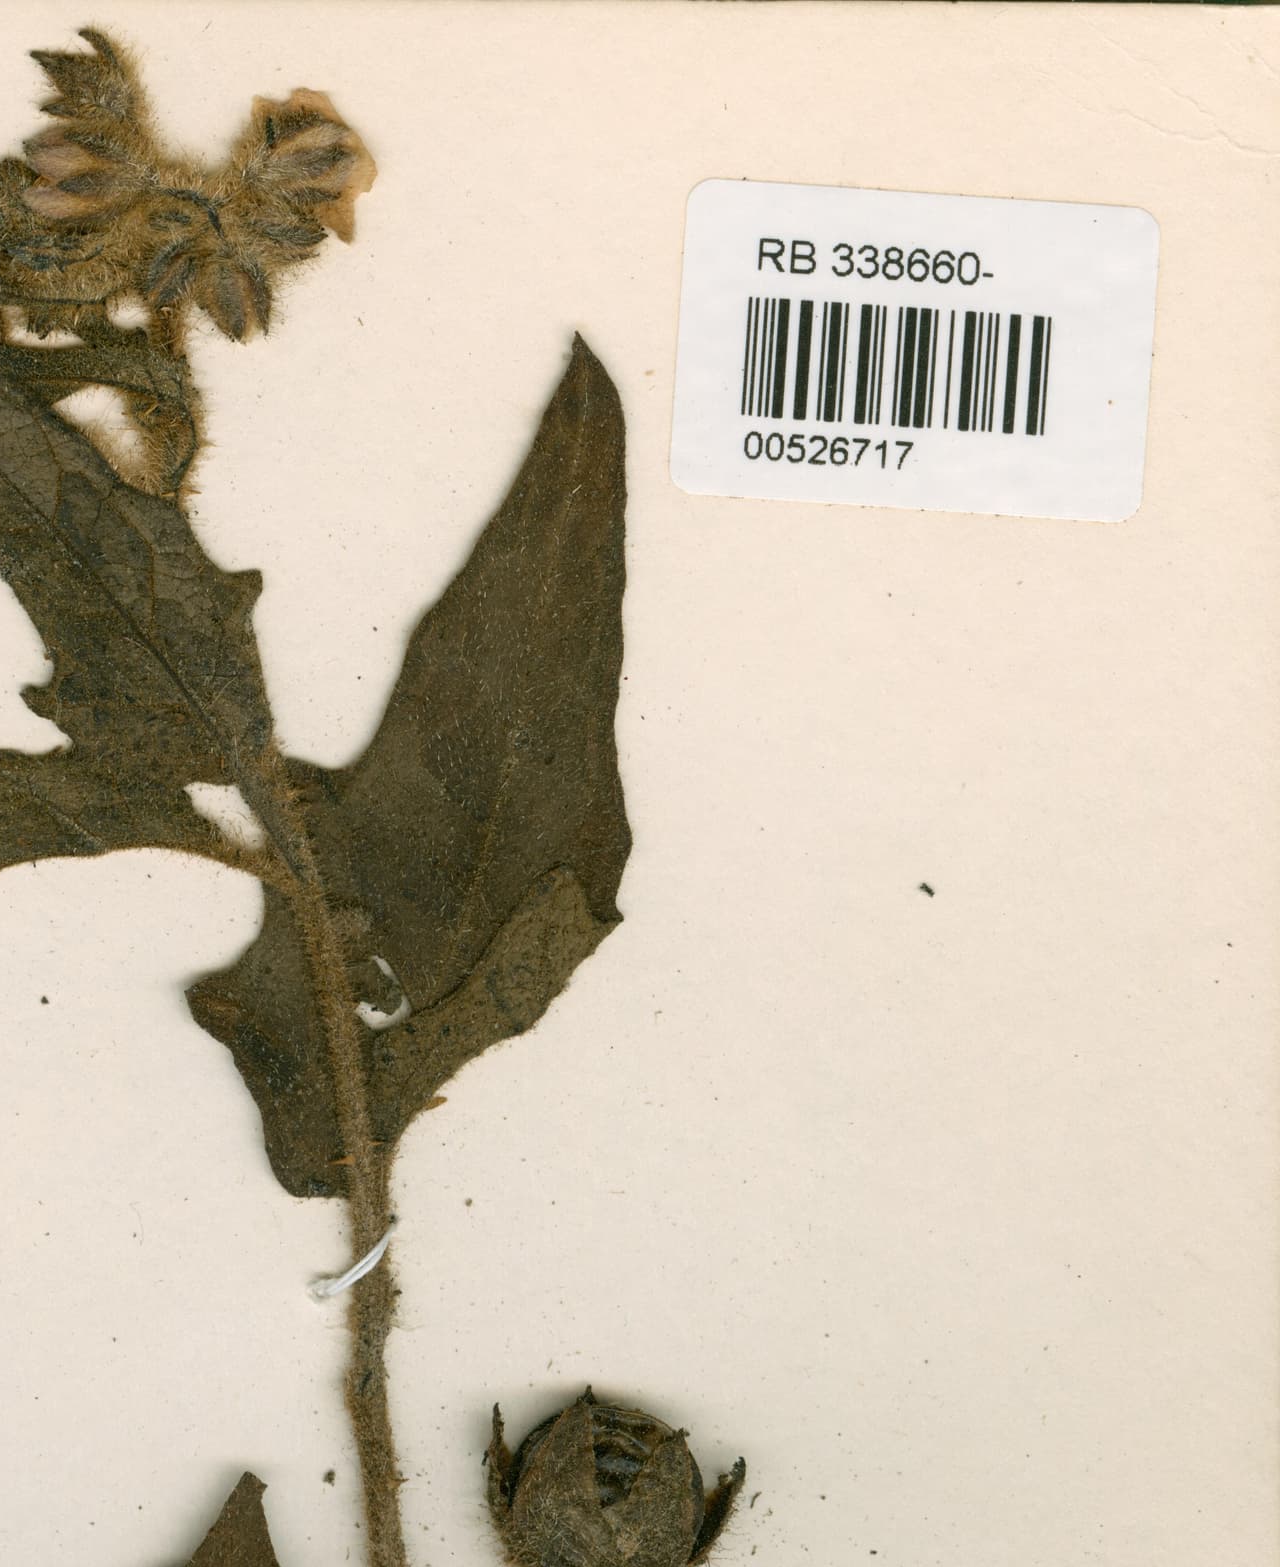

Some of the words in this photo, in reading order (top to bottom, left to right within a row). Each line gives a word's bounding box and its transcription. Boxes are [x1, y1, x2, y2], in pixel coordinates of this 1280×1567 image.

[758, 238, 816, 275] RB
[832, 243, 994, 286] 338660-
[744, 431, 914, 470] 00526717
